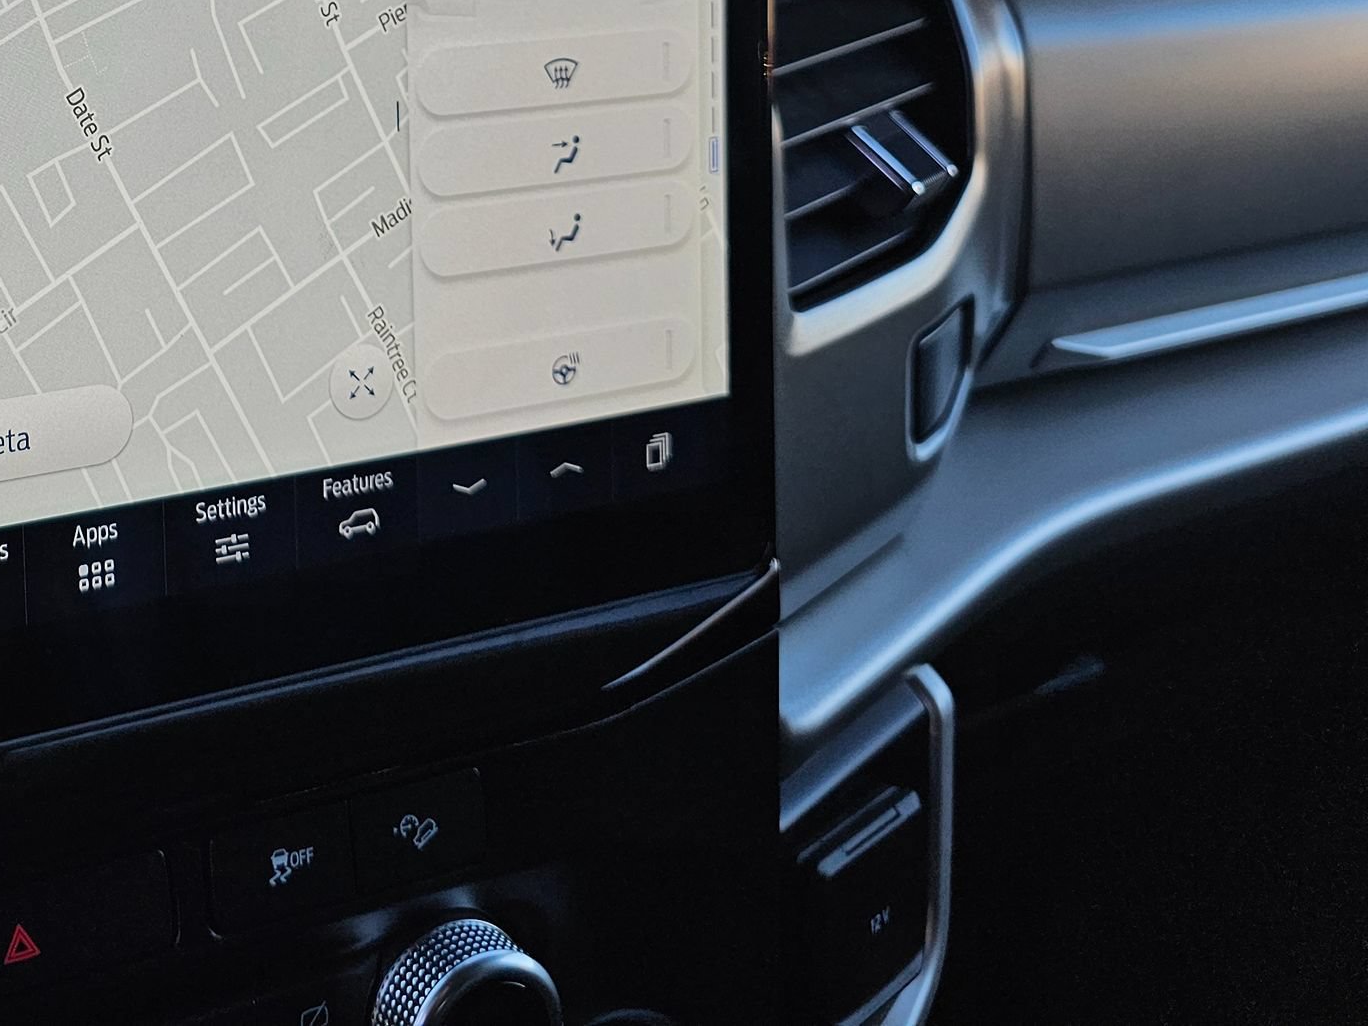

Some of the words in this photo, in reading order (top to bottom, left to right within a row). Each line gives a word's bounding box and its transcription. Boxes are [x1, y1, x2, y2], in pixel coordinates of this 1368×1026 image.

[320, 1, 340, 27] St
[66, 87, 98, 137] Date
[90, 135, 112, 162] St
[371, 198, 412, 238] Madi
[367, 305, 409, 382] Raintree
[322, 468, 394, 500] Features
[195, 492, 267, 525] Settings
[72, 520, 119, 549] Apps
[290, 846, 314, 868] OFF
